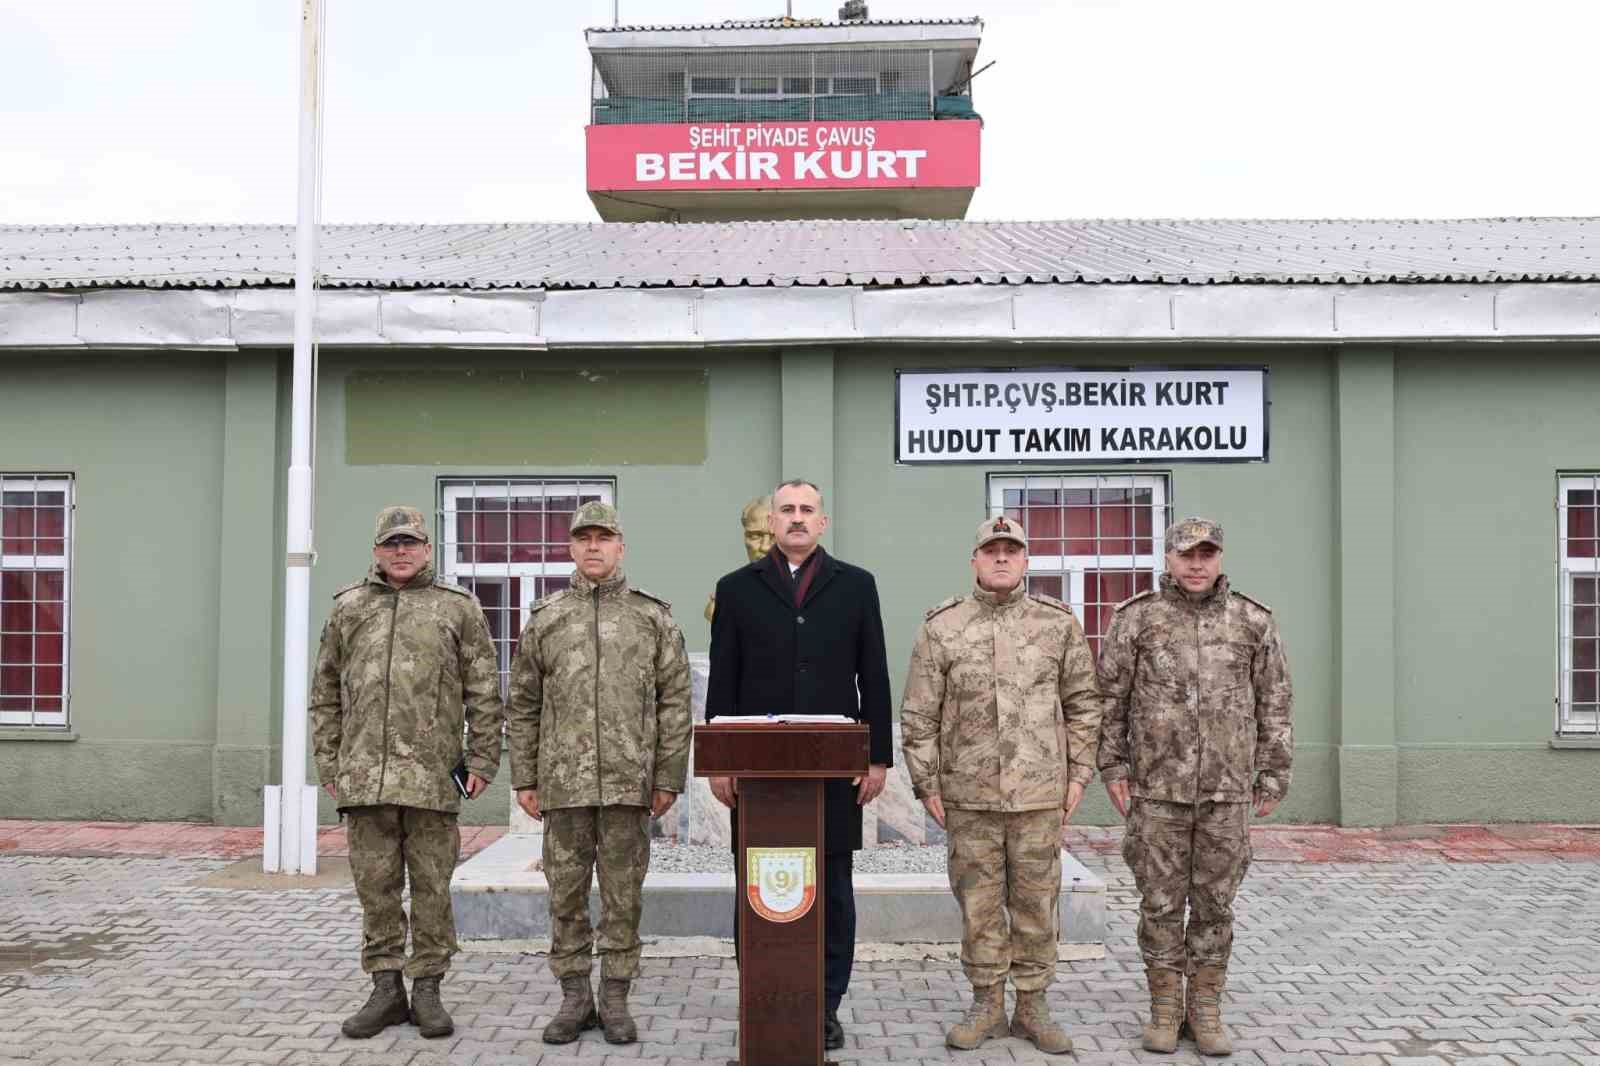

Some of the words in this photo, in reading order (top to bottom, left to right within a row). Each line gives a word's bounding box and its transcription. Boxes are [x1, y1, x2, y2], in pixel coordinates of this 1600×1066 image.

[689, 123, 741, 149] ŞEHİT
[746, 123, 809, 148] PİYADE
[815, 126, 876, 151] ÇAVUŞ
[635, 145, 780, 181] BEKİR
[794, 150, 927, 179] KURT
[1156, 381, 1229, 406] KURT
[908, 429, 1000, 453] HUDUT
[1009, 428, 1091, 452] TAKIM
[1101, 426, 1247, 451] KARAKOLU
[775, 870, 789, 889] 9
